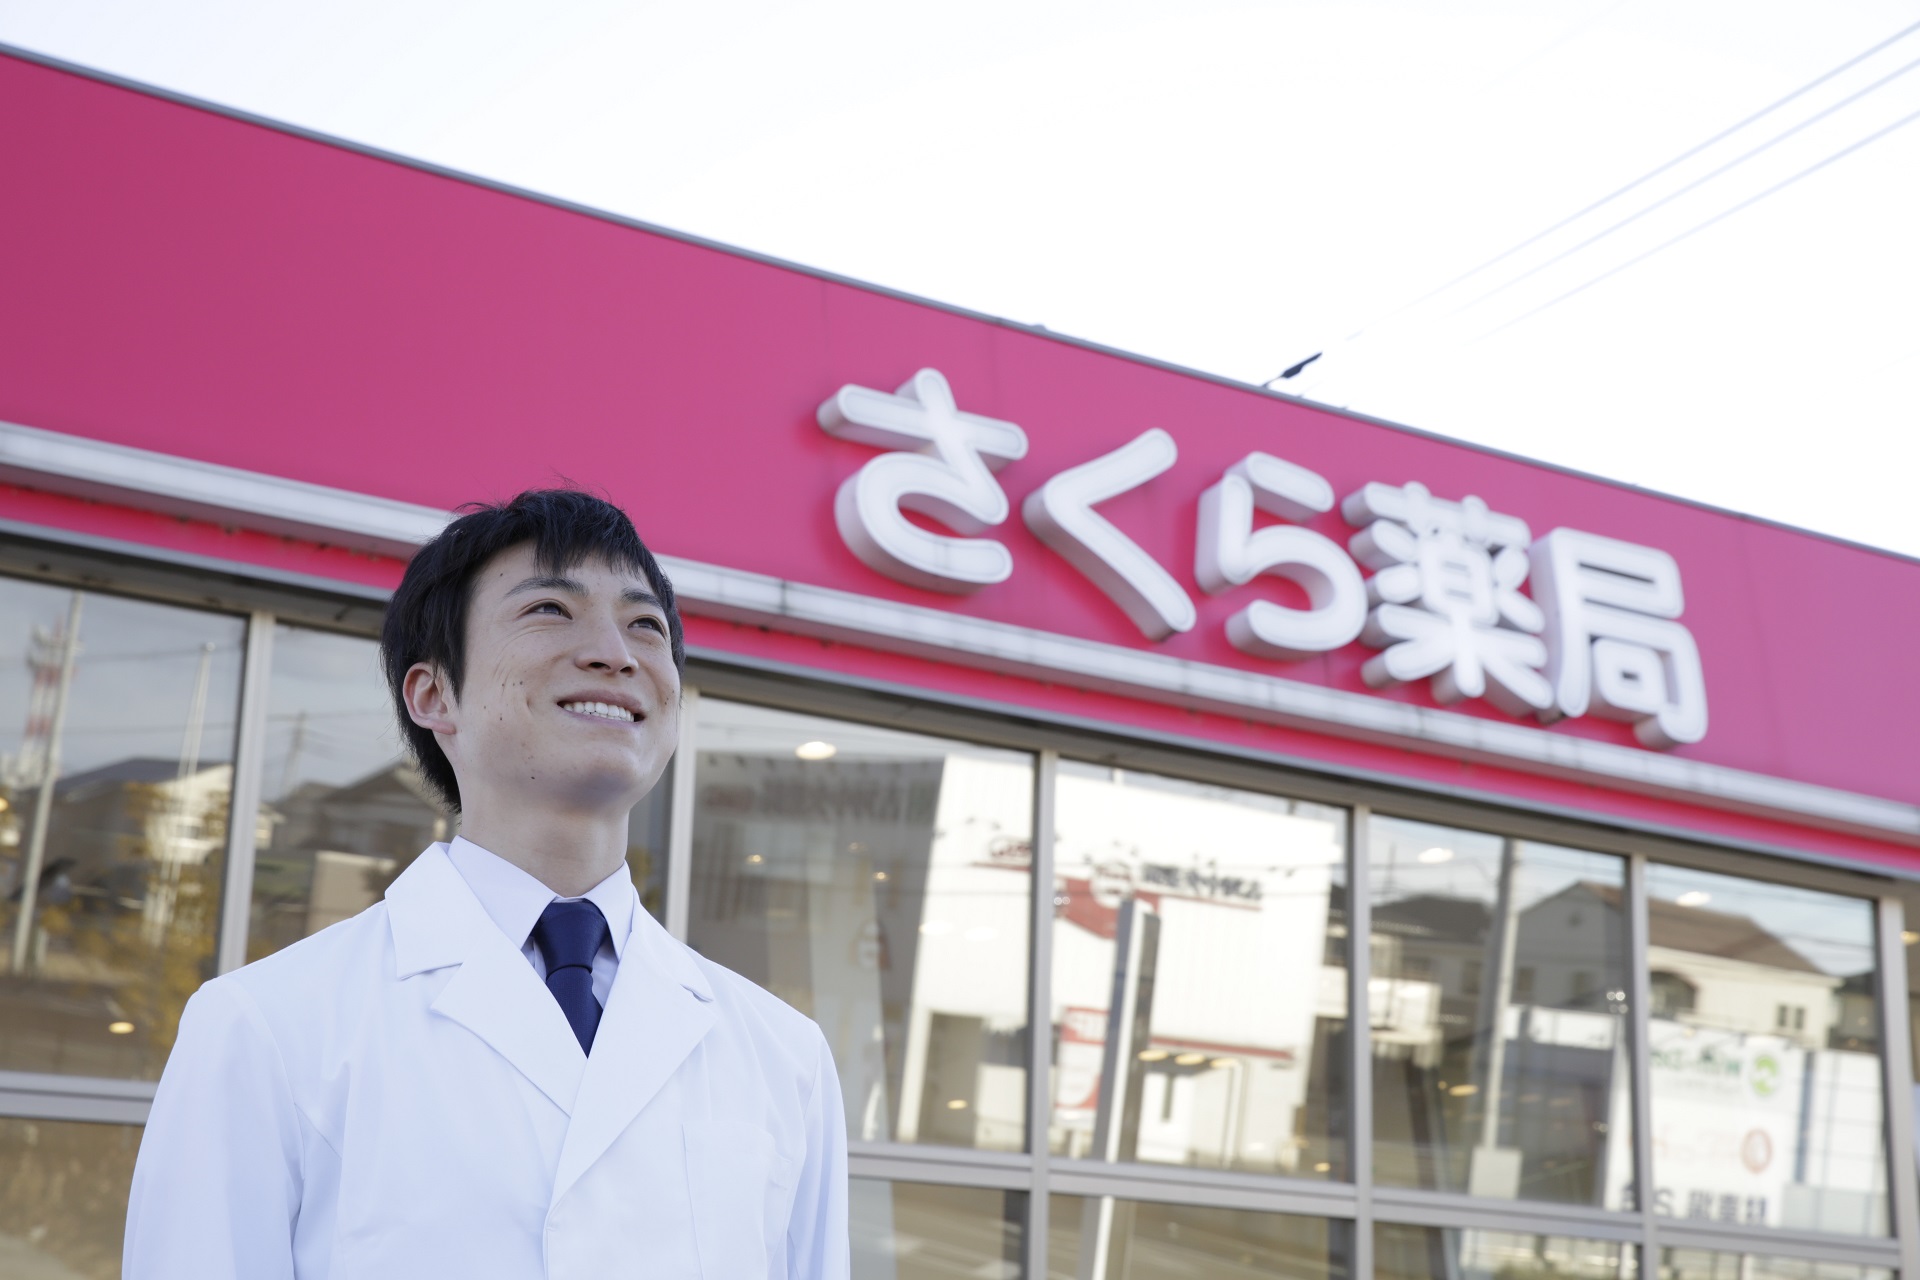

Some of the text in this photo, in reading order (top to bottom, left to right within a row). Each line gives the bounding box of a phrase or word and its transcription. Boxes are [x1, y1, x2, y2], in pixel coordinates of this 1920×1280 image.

[816, 368, 1708, 746] さくら薬局
